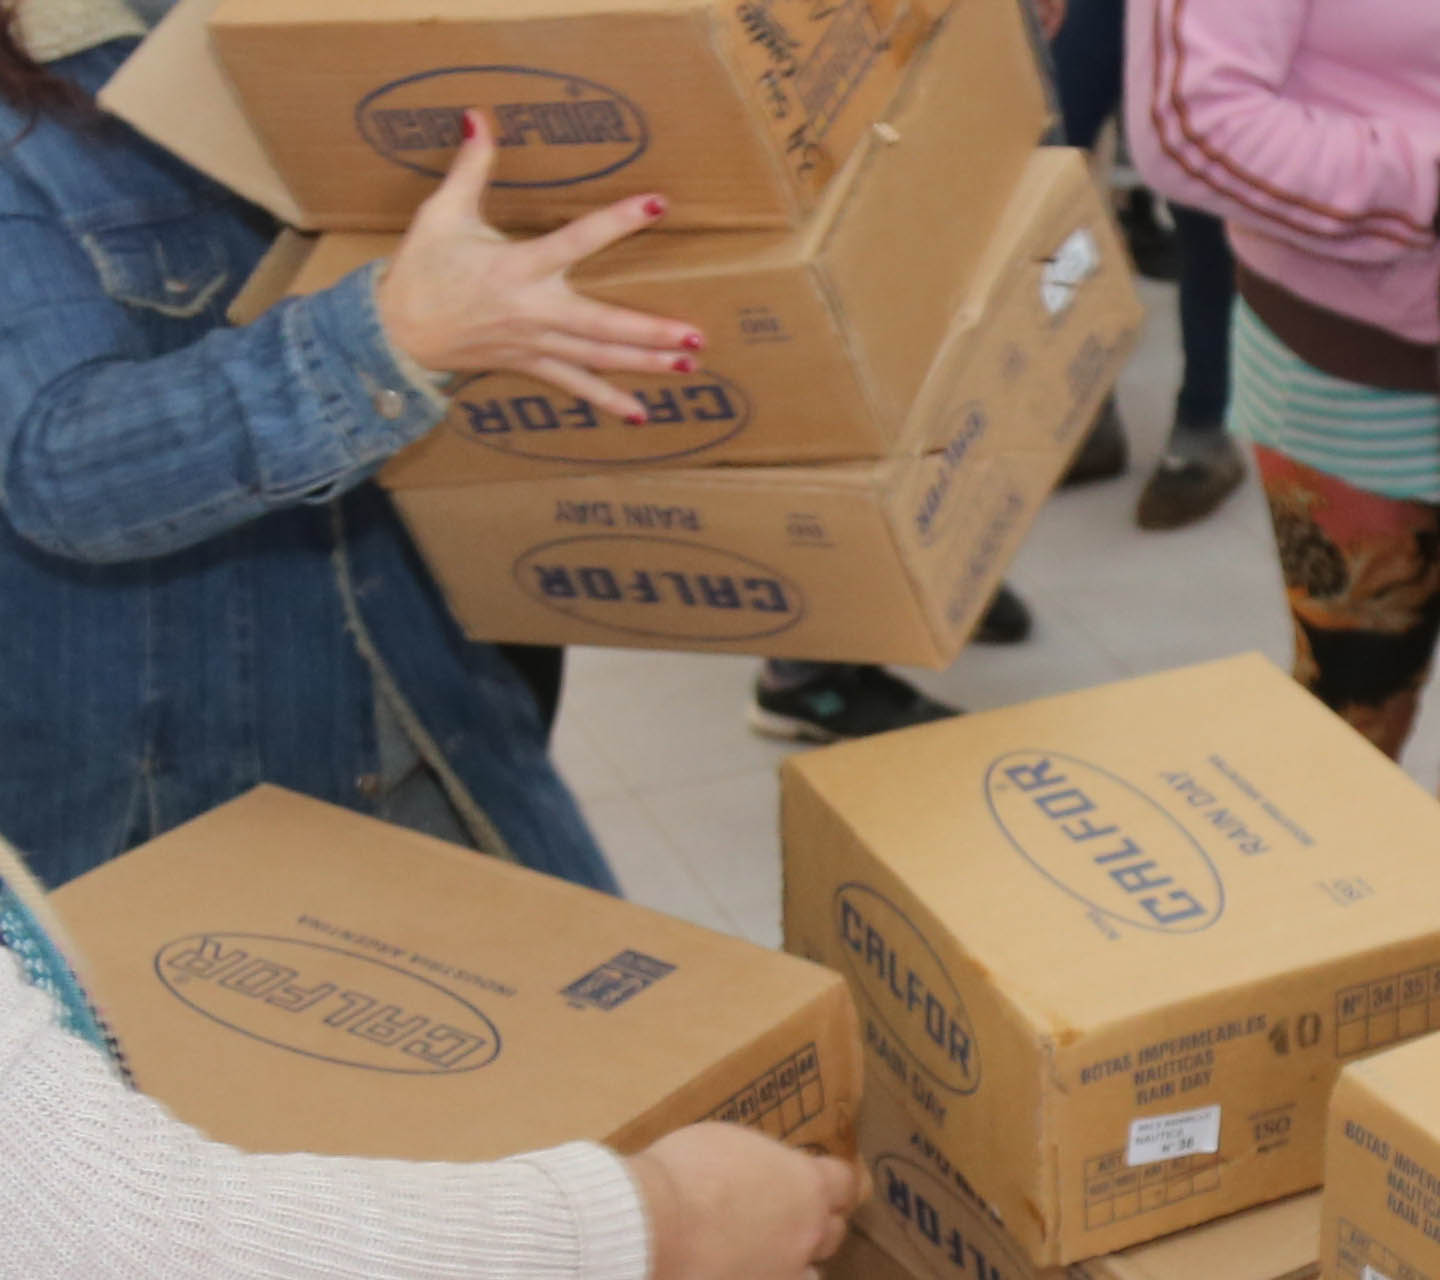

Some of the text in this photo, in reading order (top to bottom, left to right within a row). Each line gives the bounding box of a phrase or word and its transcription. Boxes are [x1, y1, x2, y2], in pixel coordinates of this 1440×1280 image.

[535, 565, 788, 614] CALFOR
[1005, 758, 1205, 925] CALFOR
[168, 939, 486, 1069] CALFOR
[841, 899, 970, 1078] CALFOR
[1344, 1120, 1390, 1161] BOTAS
